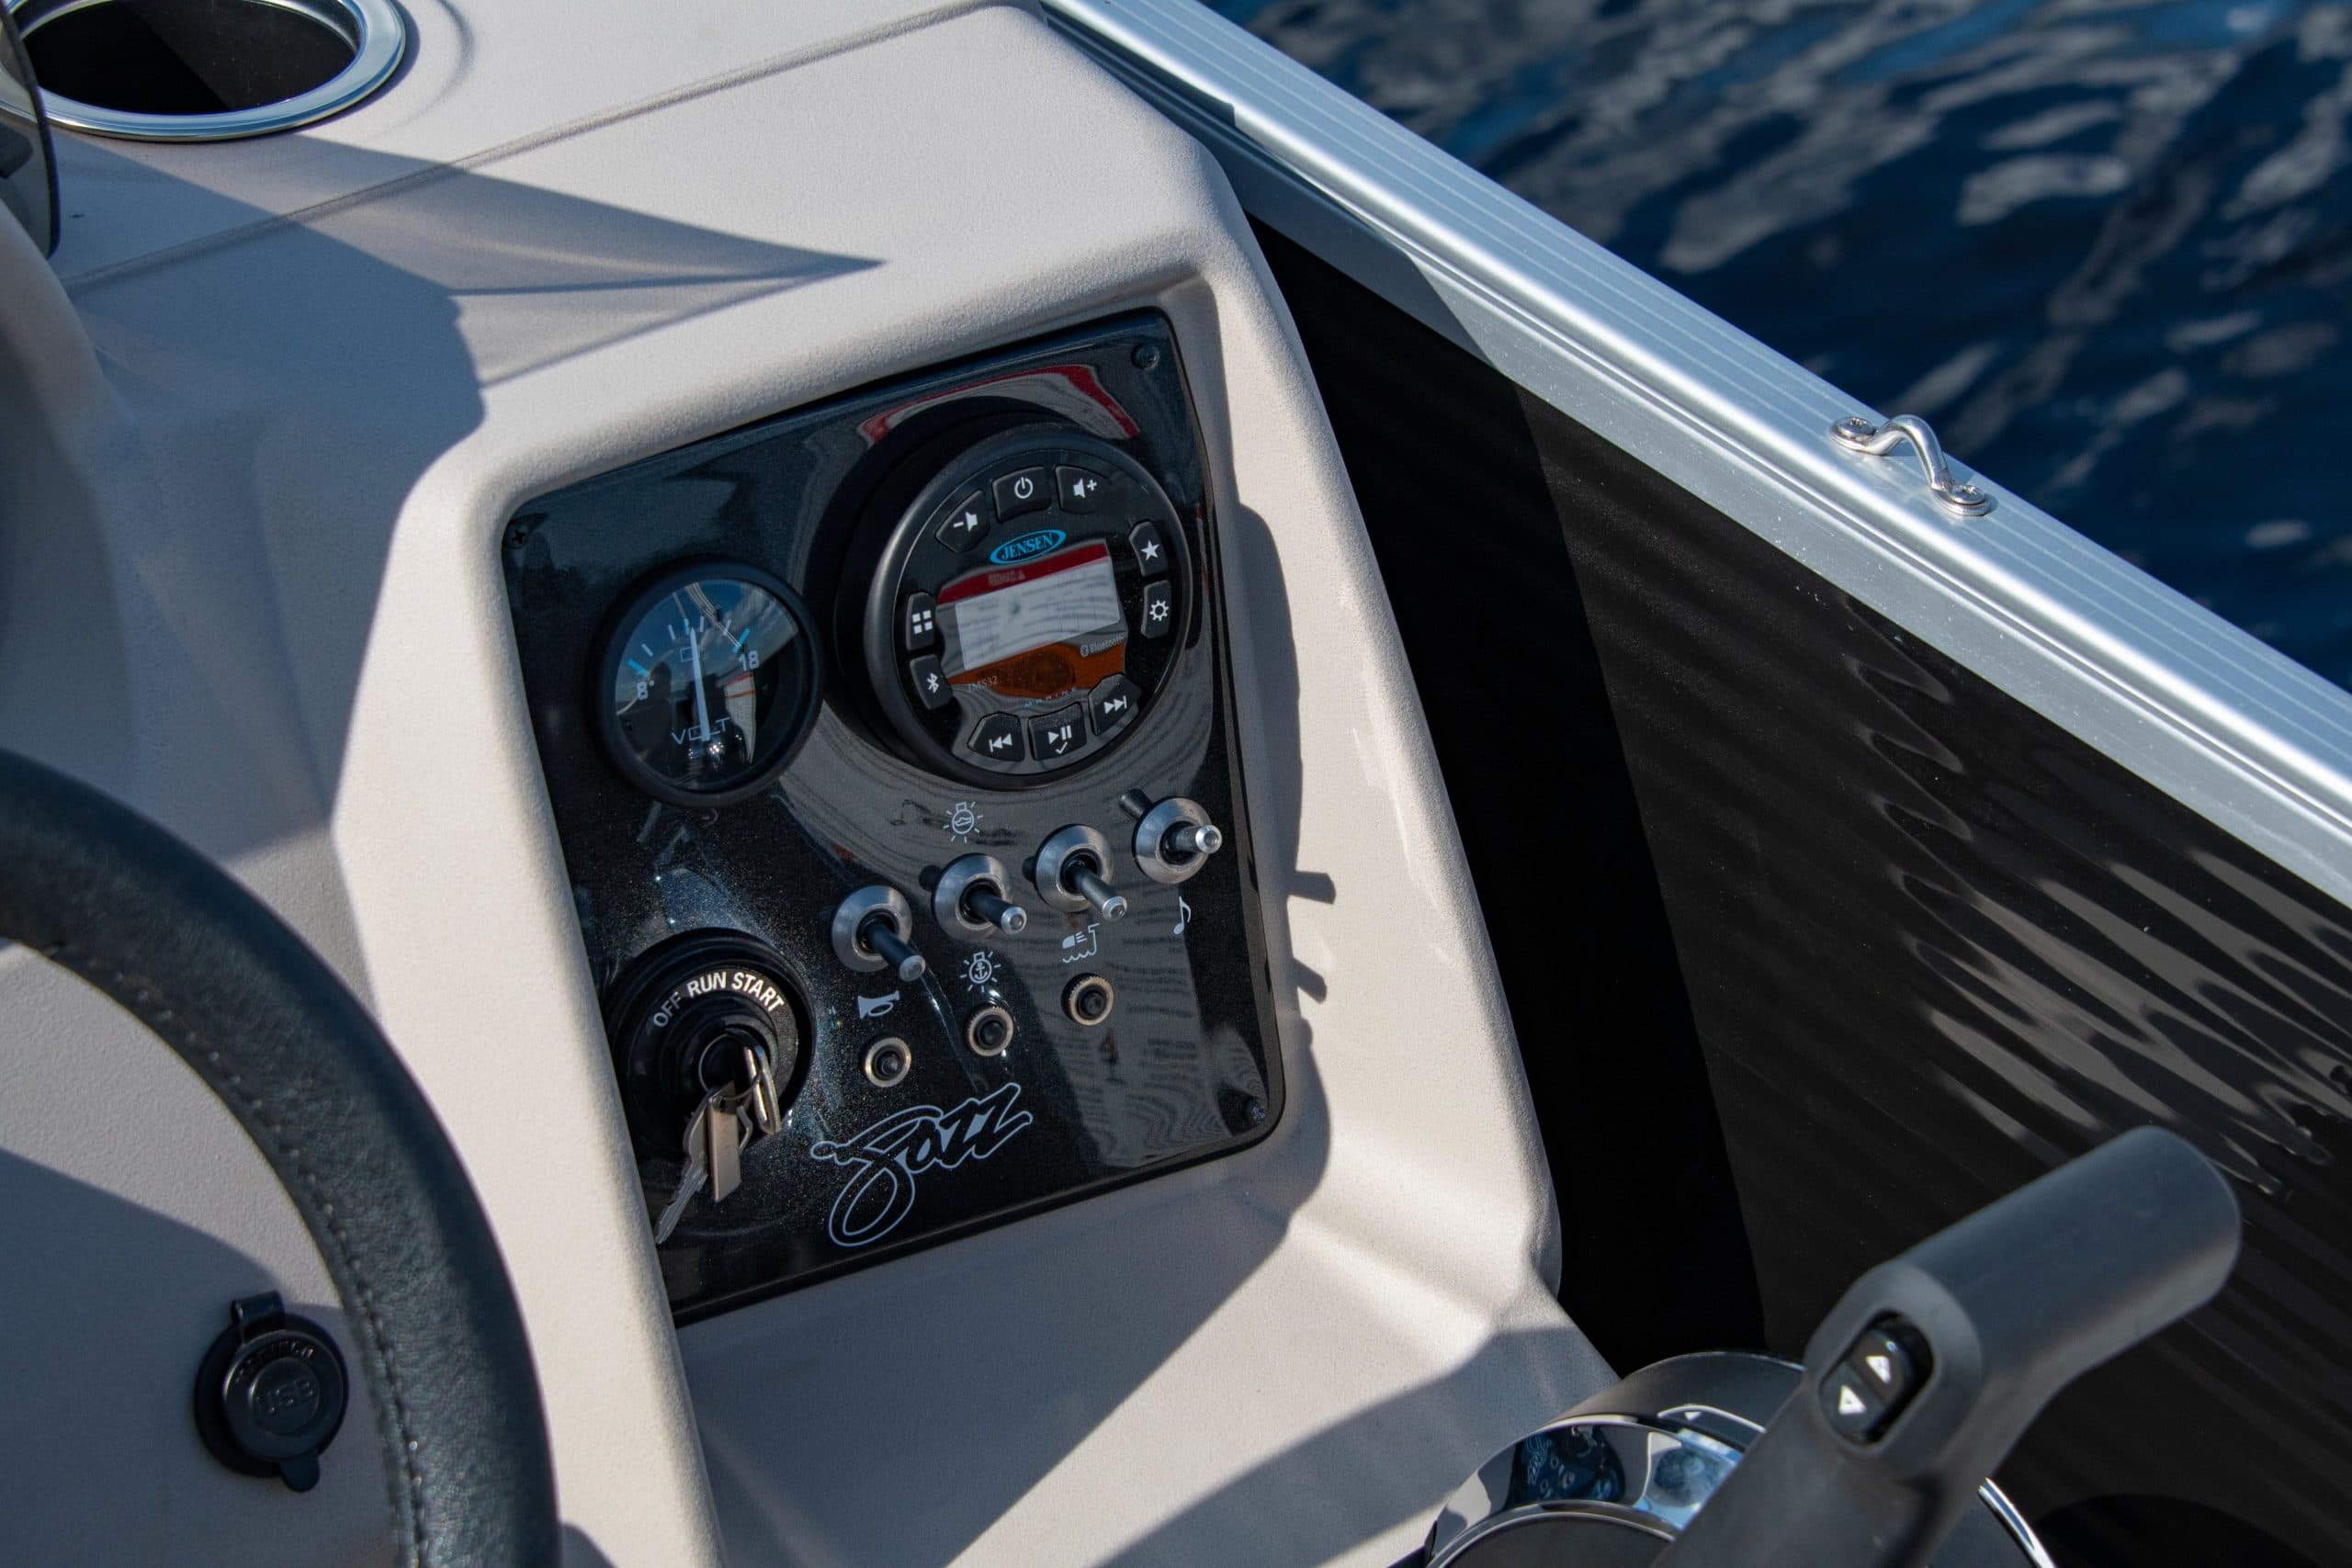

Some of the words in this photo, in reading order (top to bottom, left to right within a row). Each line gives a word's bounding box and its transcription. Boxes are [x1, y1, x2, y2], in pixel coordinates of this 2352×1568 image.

[1001, 533, 1054, 560] JENSEN
[1089, 632, 1125, 653] Bluetooth
[738, 650, 760, 671] 18
[636, 681, 649, 700] 8
[653, 991, 683, 1028] OFF
[686, 971, 727, 998] RUN
[731, 972, 786, 1012] START
